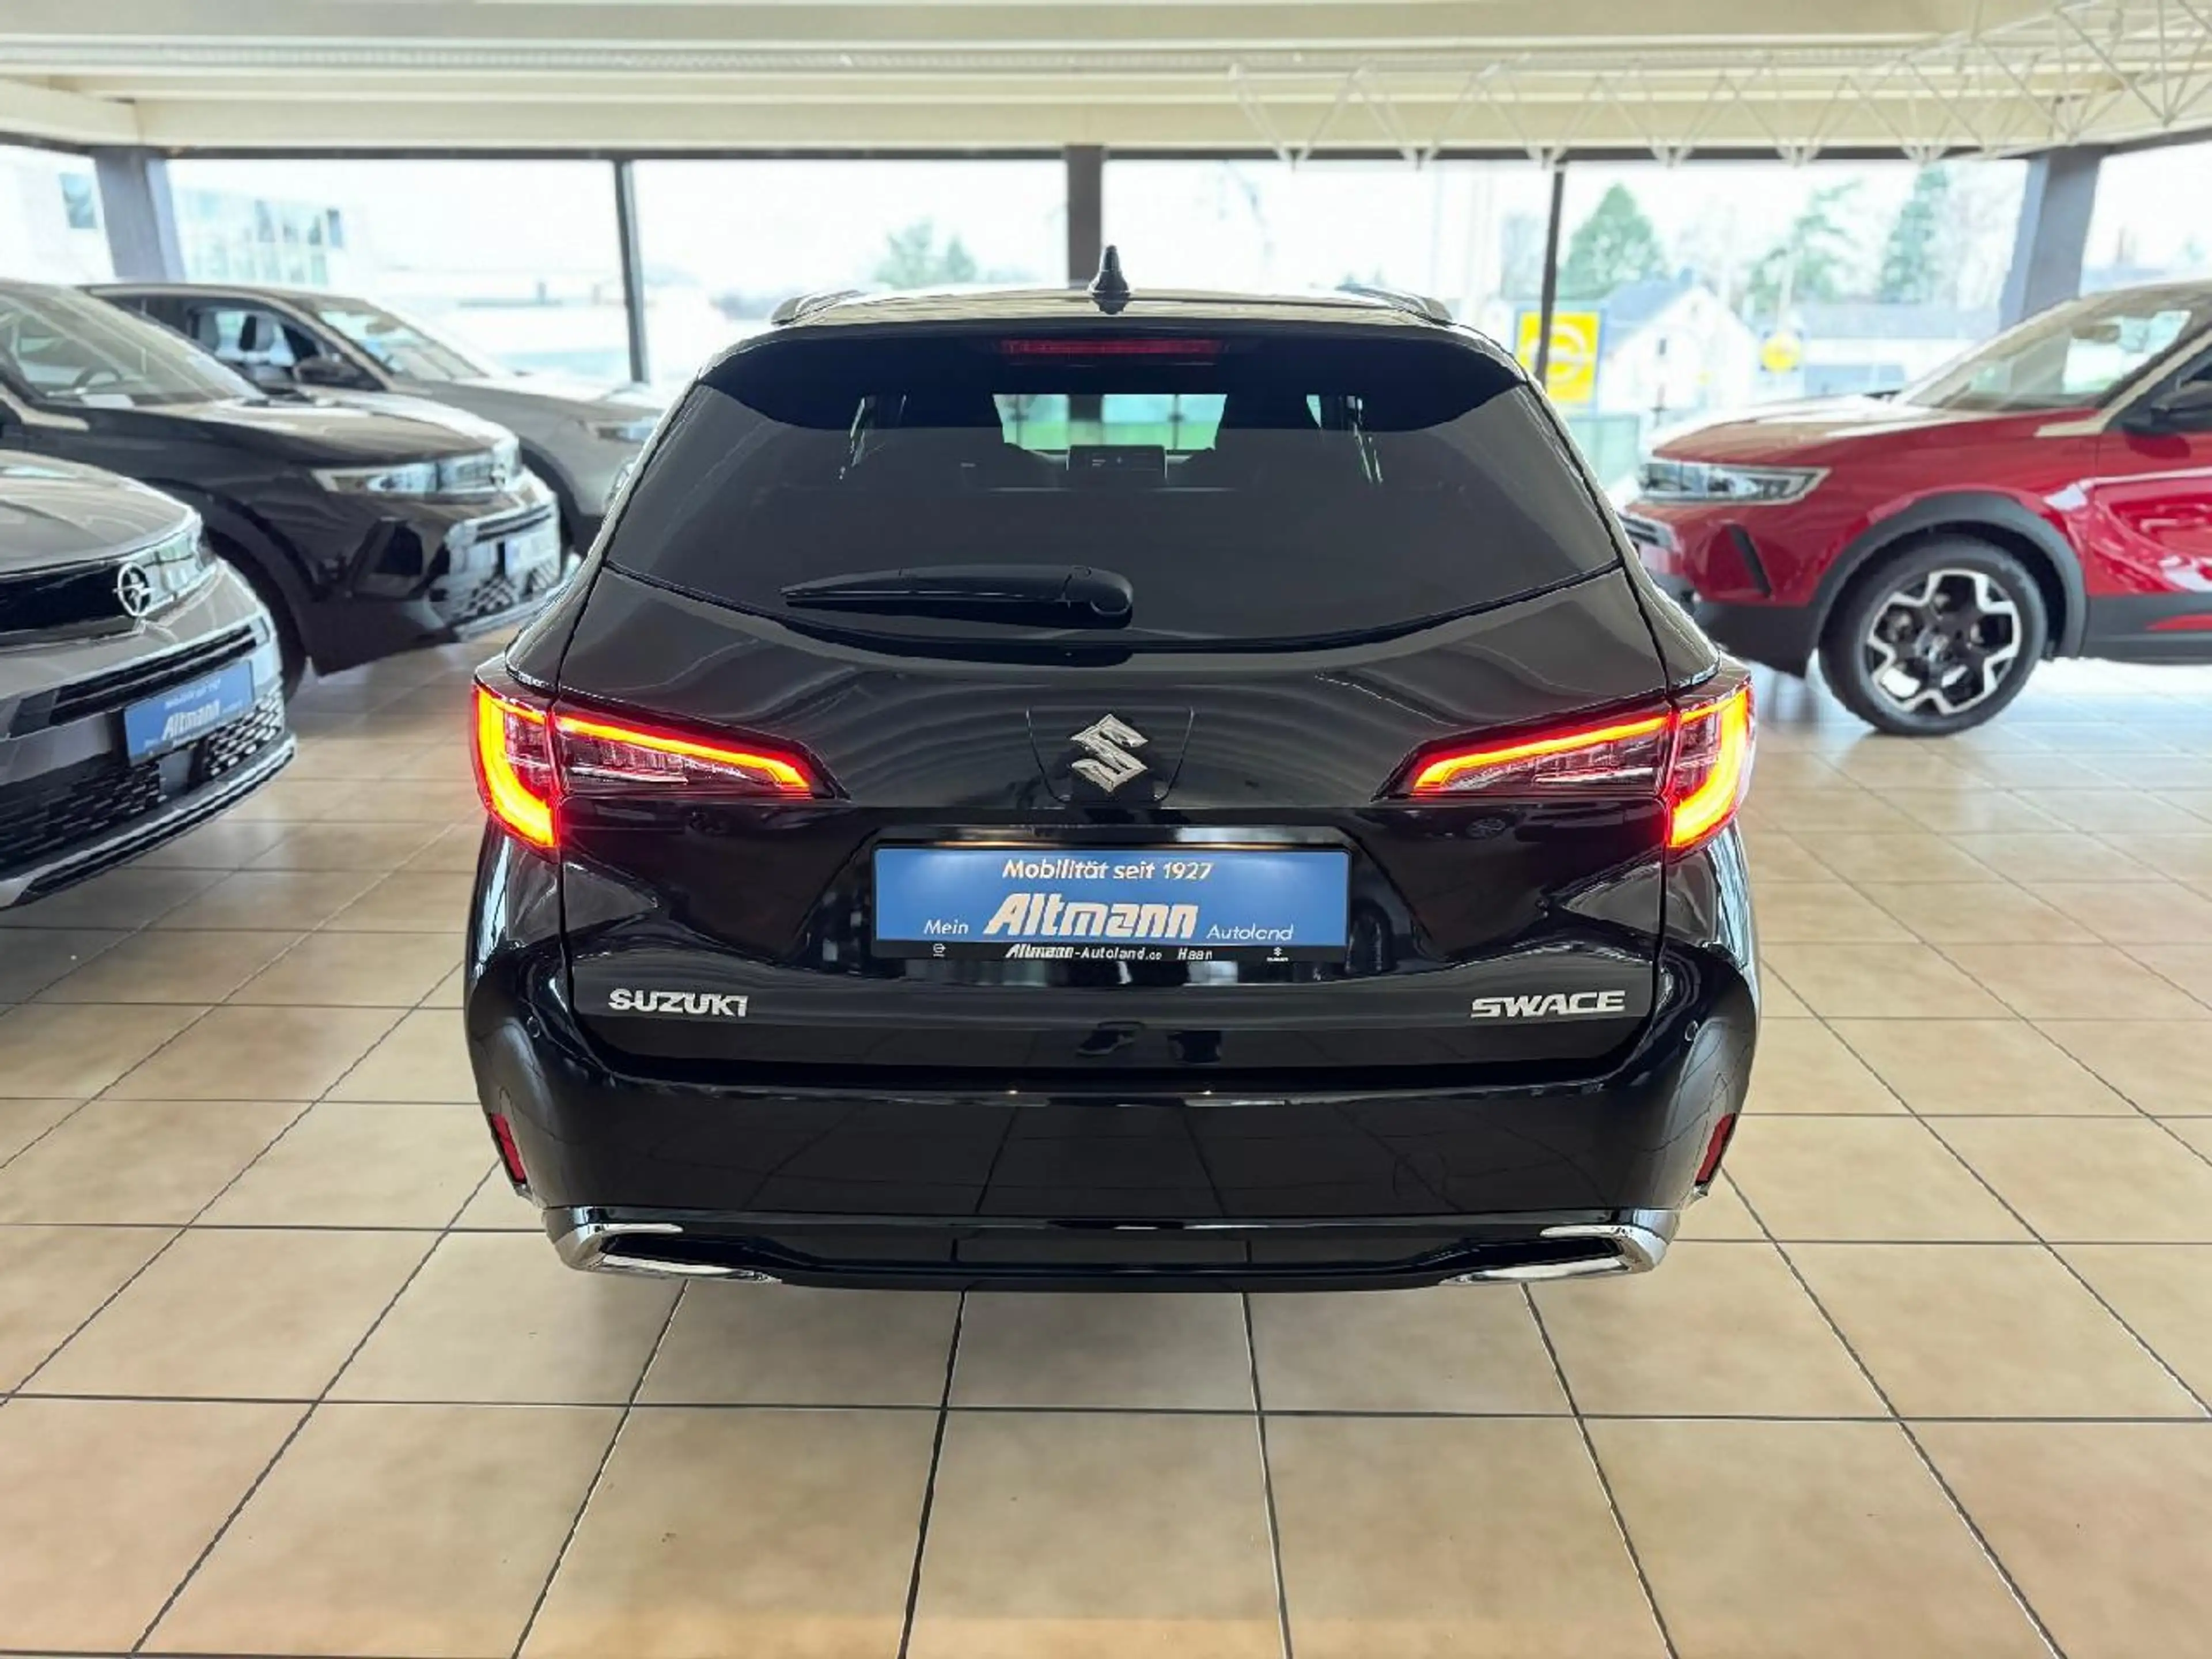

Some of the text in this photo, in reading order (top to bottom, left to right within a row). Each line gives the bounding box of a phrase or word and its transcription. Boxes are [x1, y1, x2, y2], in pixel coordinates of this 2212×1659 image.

[1002, 858, 1214, 880] Mobilität seit 1927
[982, 893, 1198, 938] Altmann
[923, 920, 969, 934] Mein
[1206, 923, 1294, 941] Autoland
[1177, 948, 1212, 961] Haan
[608, 988, 748, 1017] SUZUKI
[1471, 990, 1626, 1018] SWACE
